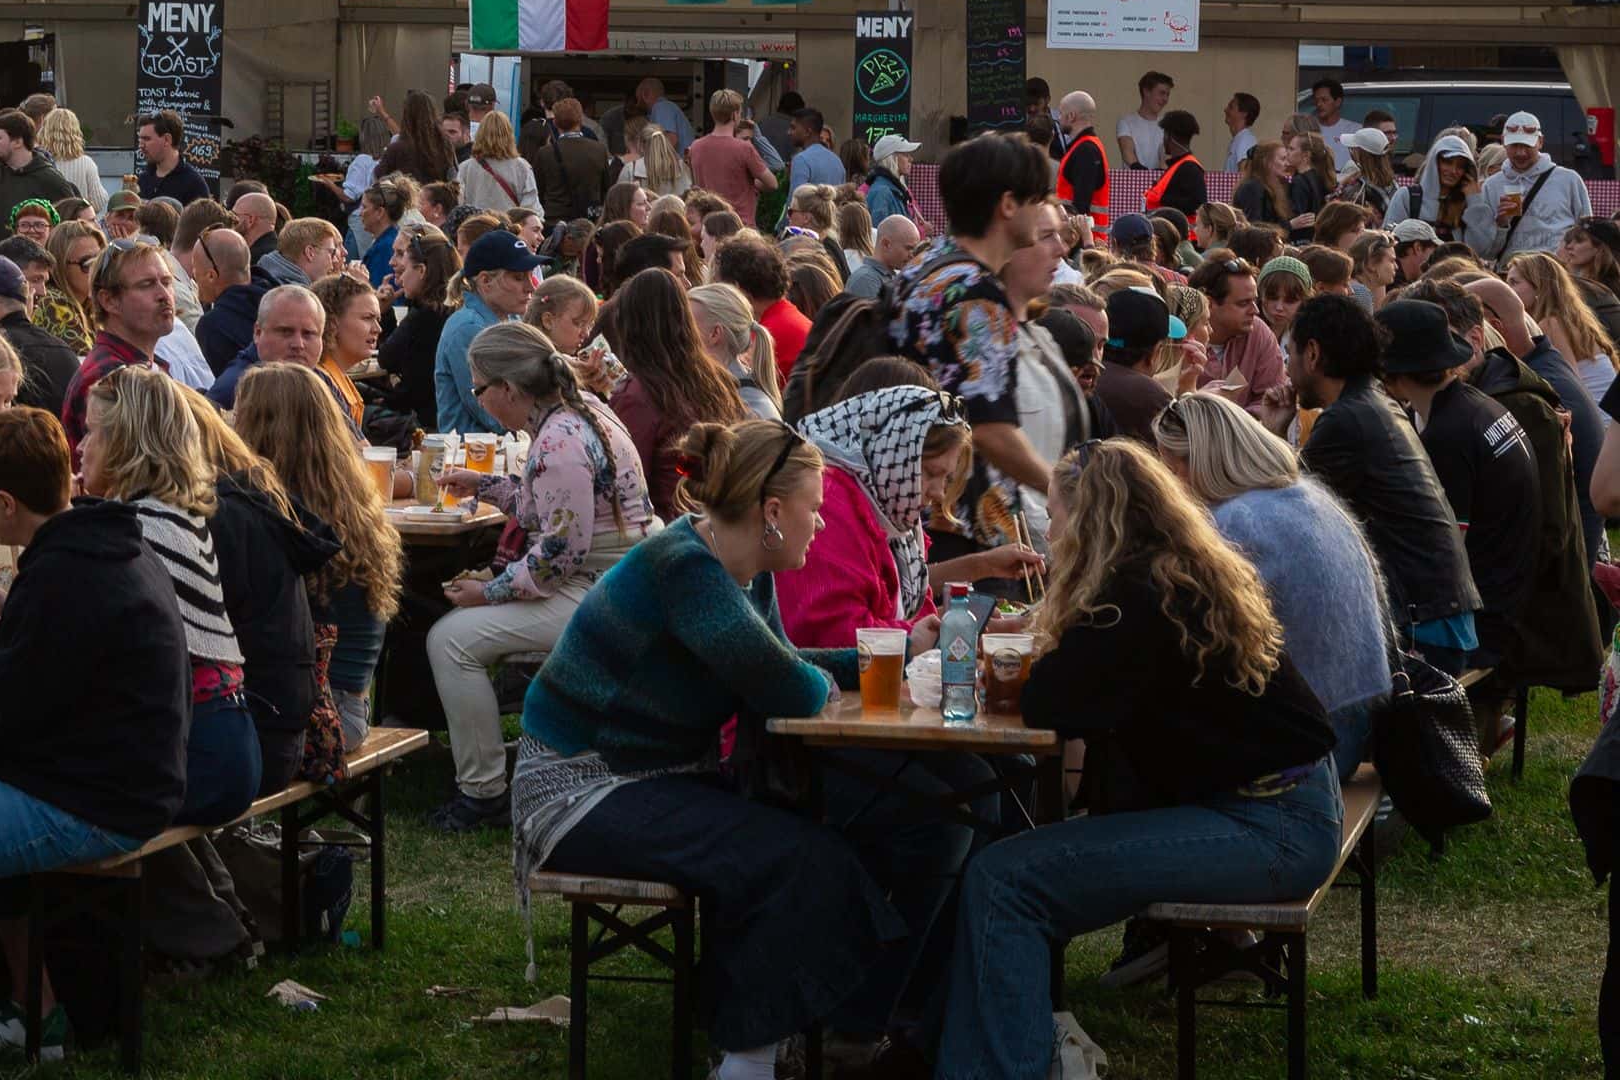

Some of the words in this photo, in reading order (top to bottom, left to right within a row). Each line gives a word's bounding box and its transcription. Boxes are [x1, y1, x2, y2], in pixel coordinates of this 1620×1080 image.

[147, 2, 215, 32] MENY
[856, 16, 912, 38] MENY
[147, 54, 209, 73] TOAST
[863, 54, 906, 81] PIZZA
[855, 113, 908, 122] MARGHERITA
